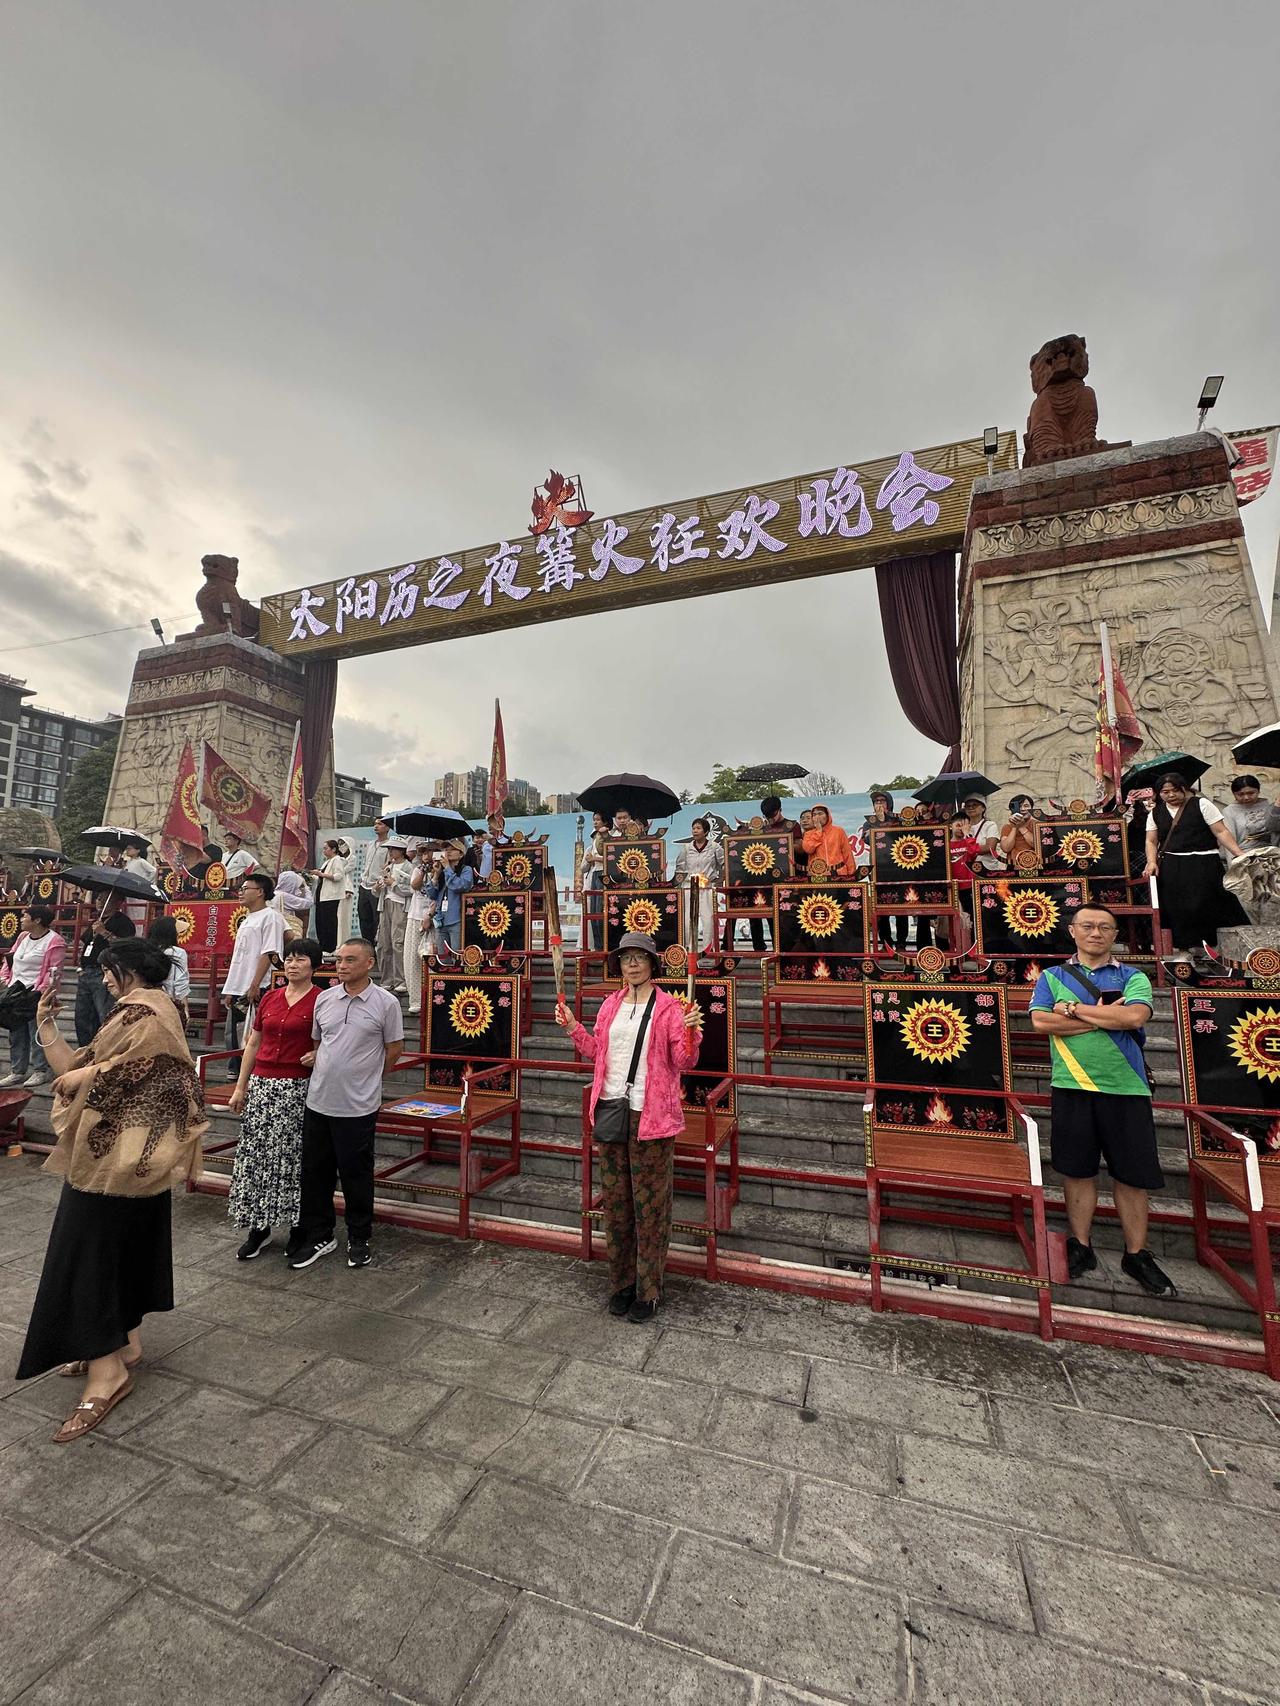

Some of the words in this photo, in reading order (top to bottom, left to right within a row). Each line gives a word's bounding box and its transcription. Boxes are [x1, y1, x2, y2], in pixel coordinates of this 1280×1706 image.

[287, 451, 955, 641] 太阳历之夜篝火狂欢晚会
[1076, 843, 1087, 853] 王
[815, 910, 826, 920] 王
[1025, 908, 1037, 919] 王
[466, 1006, 477, 1018] 王
[975, 993, 996, 1026] 部落
[927, 1024, 944, 1038] 王
